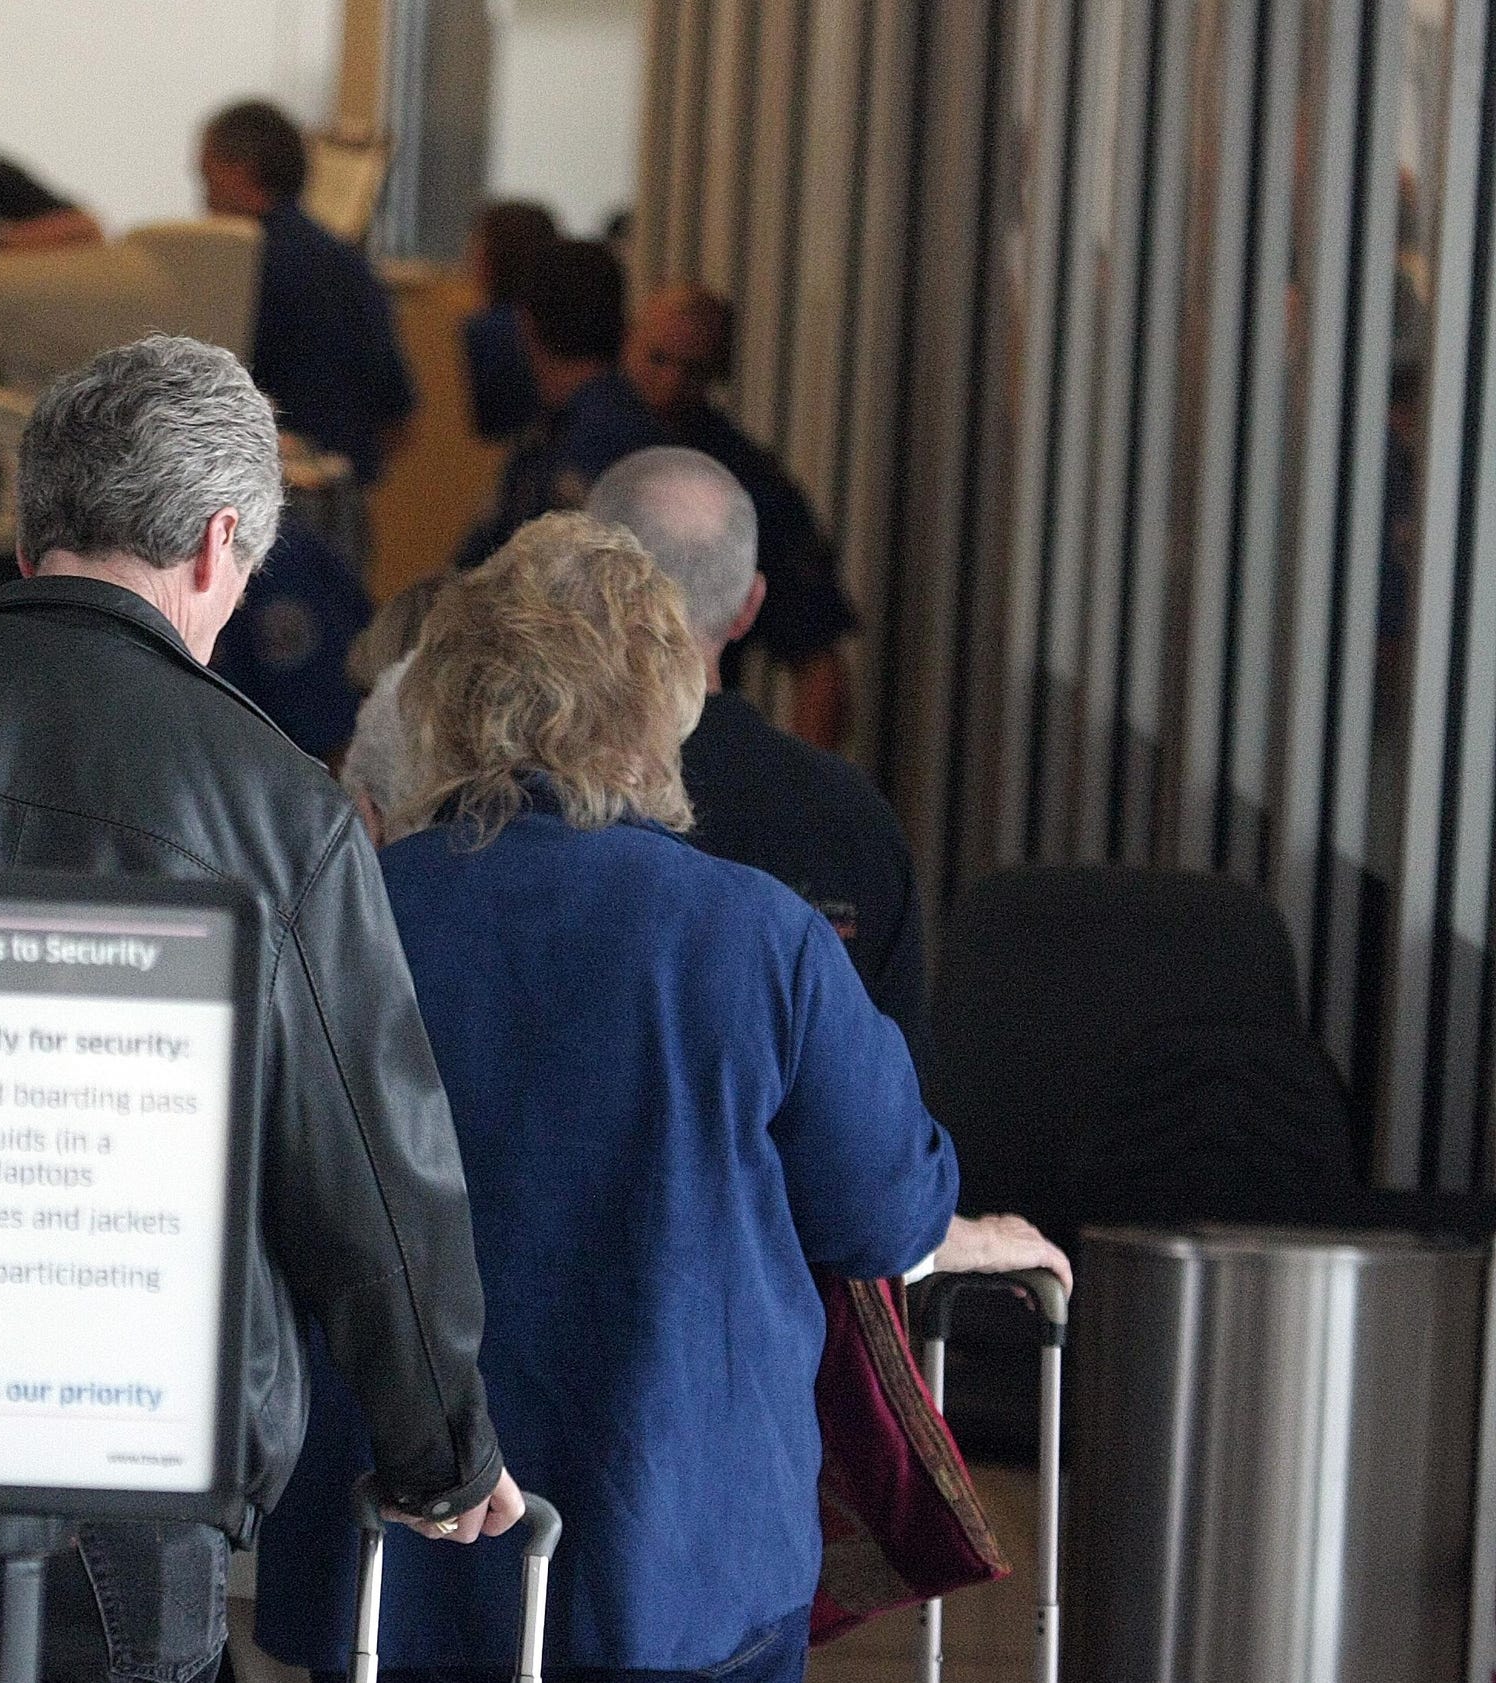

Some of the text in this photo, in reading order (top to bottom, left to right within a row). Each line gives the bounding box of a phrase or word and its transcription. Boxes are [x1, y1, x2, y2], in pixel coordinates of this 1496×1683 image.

[12, 934, 40, 964] to
[45, 934, 159, 972] Security
[29, 1028, 64, 1053] for
[75, 1032, 190, 1062] security:
[13, 1083, 131, 1117] boarding
[140, 1091, 198, 1115] pass
[56, 1129, 88, 1157] (in
[96, 1134, 112, 1156] a
[32, 1207, 80, 1232] and
[88, 1208, 181, 1237] jackets
[6, 1382, 53, 1403] our
[59, 1382, 164, 1413] priority
